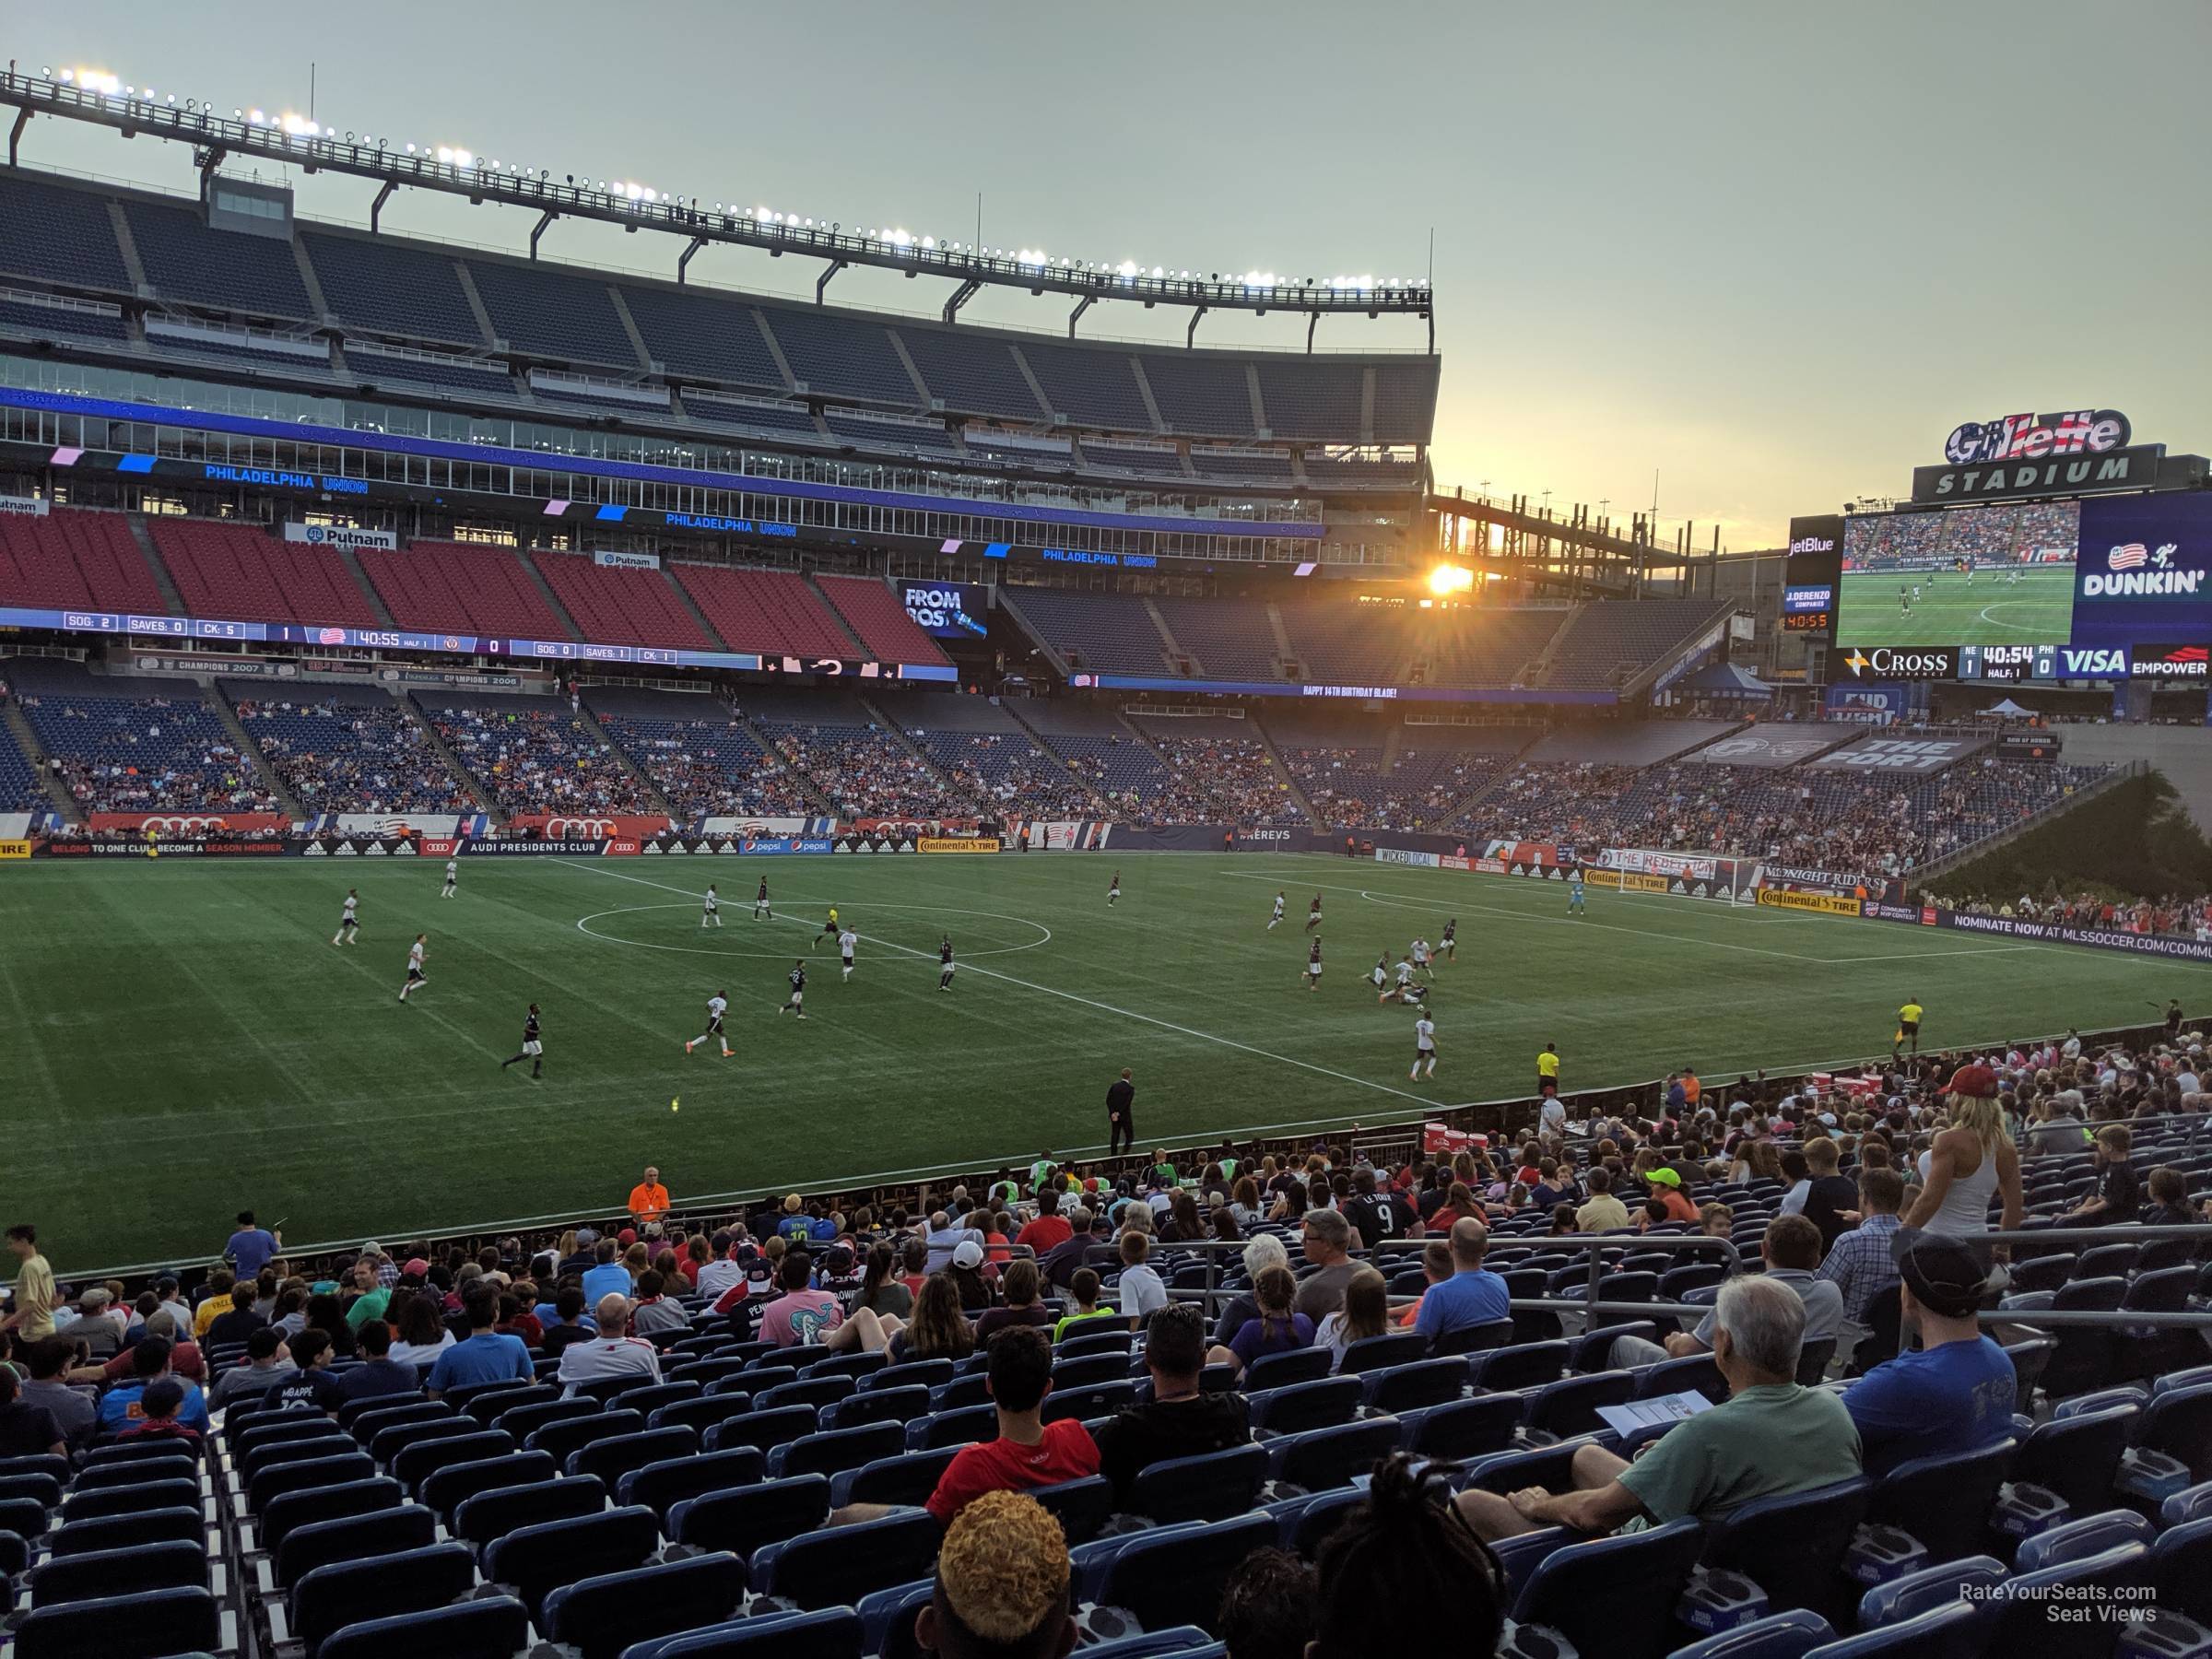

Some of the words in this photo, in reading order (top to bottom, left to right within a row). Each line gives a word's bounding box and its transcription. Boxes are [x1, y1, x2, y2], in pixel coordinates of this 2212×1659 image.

[1947, 412, 2122, 463] Gillette
[206, 465, 315, 488] PHILADELPHIA
[323, 477, 369, 494] UNION
[1936, 458, 2131, 494] STADIUM
[666, 513, 753, 533] PHILADELPHIA
[759, 523, 797, 537] UNION
[327, 530, 390, 547] Putnam
[1789, 537, 1834, 557] jetBlue
[615, 556, 650, 567] Putnam
[1043, 549, 1118, 566] PHILADELPHIA
[1124, 556, 1158, 569] UNION
[2084, 571, 2206, 596] DUNKIN'
[905, 589, 961, 610] FROM
[1786, 590, 1830, 603] J.DERENZO
[1794, 600, 1826, 610] COMPANIES
[69, 617, 95, 628] SOG:
[101, 618, 110, 628] 2
[131, 619, 168, 632] SAVES:
[174, 622, 182, 632] 0
[1789, 614, 1828, 628] 40:55
[205, 624, 220, 634] CK:
[227, 626, 235, 635] 5
[283, 627, 289, 640] 1
[360, 631, 399, 646] 40:55
[404, 640, 420, 648] HALF
[489, 641, 499, 653] 0
[537, 644, 558, 655] SOG:
[563, 646, 570, 654] 0
[586, 647, 616, 659] SAVES:
[619, 648, 625, 658] 1
[1965, 646, 1976, 654] NE
[2039, 646, 2054, 654] PHI
[643, 651, 657, 660] CK:
[664, 653, 668, 661] 1
[1983, 647, 2034, 665] 40:54
[2062, 650, 2126, 673] VISA
[178, 661, 229, 673] CHAMPIONS
[232, 664, 259, 673] 2007
[1967, 661, 1972, 674] 1
[1987, 668, 2014, 678] HALF:
[2040, 660, 2050, 673] 0
[2133, 662, 2207, 675] EMPOWER
[444, 675, 488, 684] CHAMPIONS
[1303, 685, 1324, 697] HAPPY
[1324, 686, 1341, 697] 14TH
[1341, 687, 1373, 698] BIRTHDAY
[1374, 688, 1397, 699] BLADE!
[1863, 740, 1962, 754] THE
[1817, 751, 1954, 768] FORT
[91, 844, 105, 853] TO
[107, 844, 127, 853] ONE
[158, 844, 195, 853] BECOME
[196, 844, 205, 853] A
[206, 843, 242, 853] SEASON
[471, 842, 497, 853] AUDI
[500, 842, 567, 853] PRESIDENTS
[570, 842, 595, 853] CLUB
[757, 842, 781, 853] pepsi
[803, 842, 827, 853] pepsi
[921, 840, 969, 853] Continental
[1616, 851, 1638, 864] THE
[1587, 870, 1636, 888] Continental
[1645, 880, 1665, 888] TIRE
[1765, 865, 1830, 883] MIDNIGHT
[1761, 889, 1820, 909] Continental
[1833, 900, 1858, 912] TIRE
[1881, 905, 1912, 914] COMMUNITY
[1892, 912, 1916, 921] CONTEST
[1955, 914, 2012, 933] NOMINATE
[2015, 923, 2043, 936] NOW
[2045, 927, 2062, 937] AT
[1363, 1195, 1375, 1204] LE
[1374, 1194, 1393, 1202] TOUX
[1377, 1204, 1394, 1234] 9
